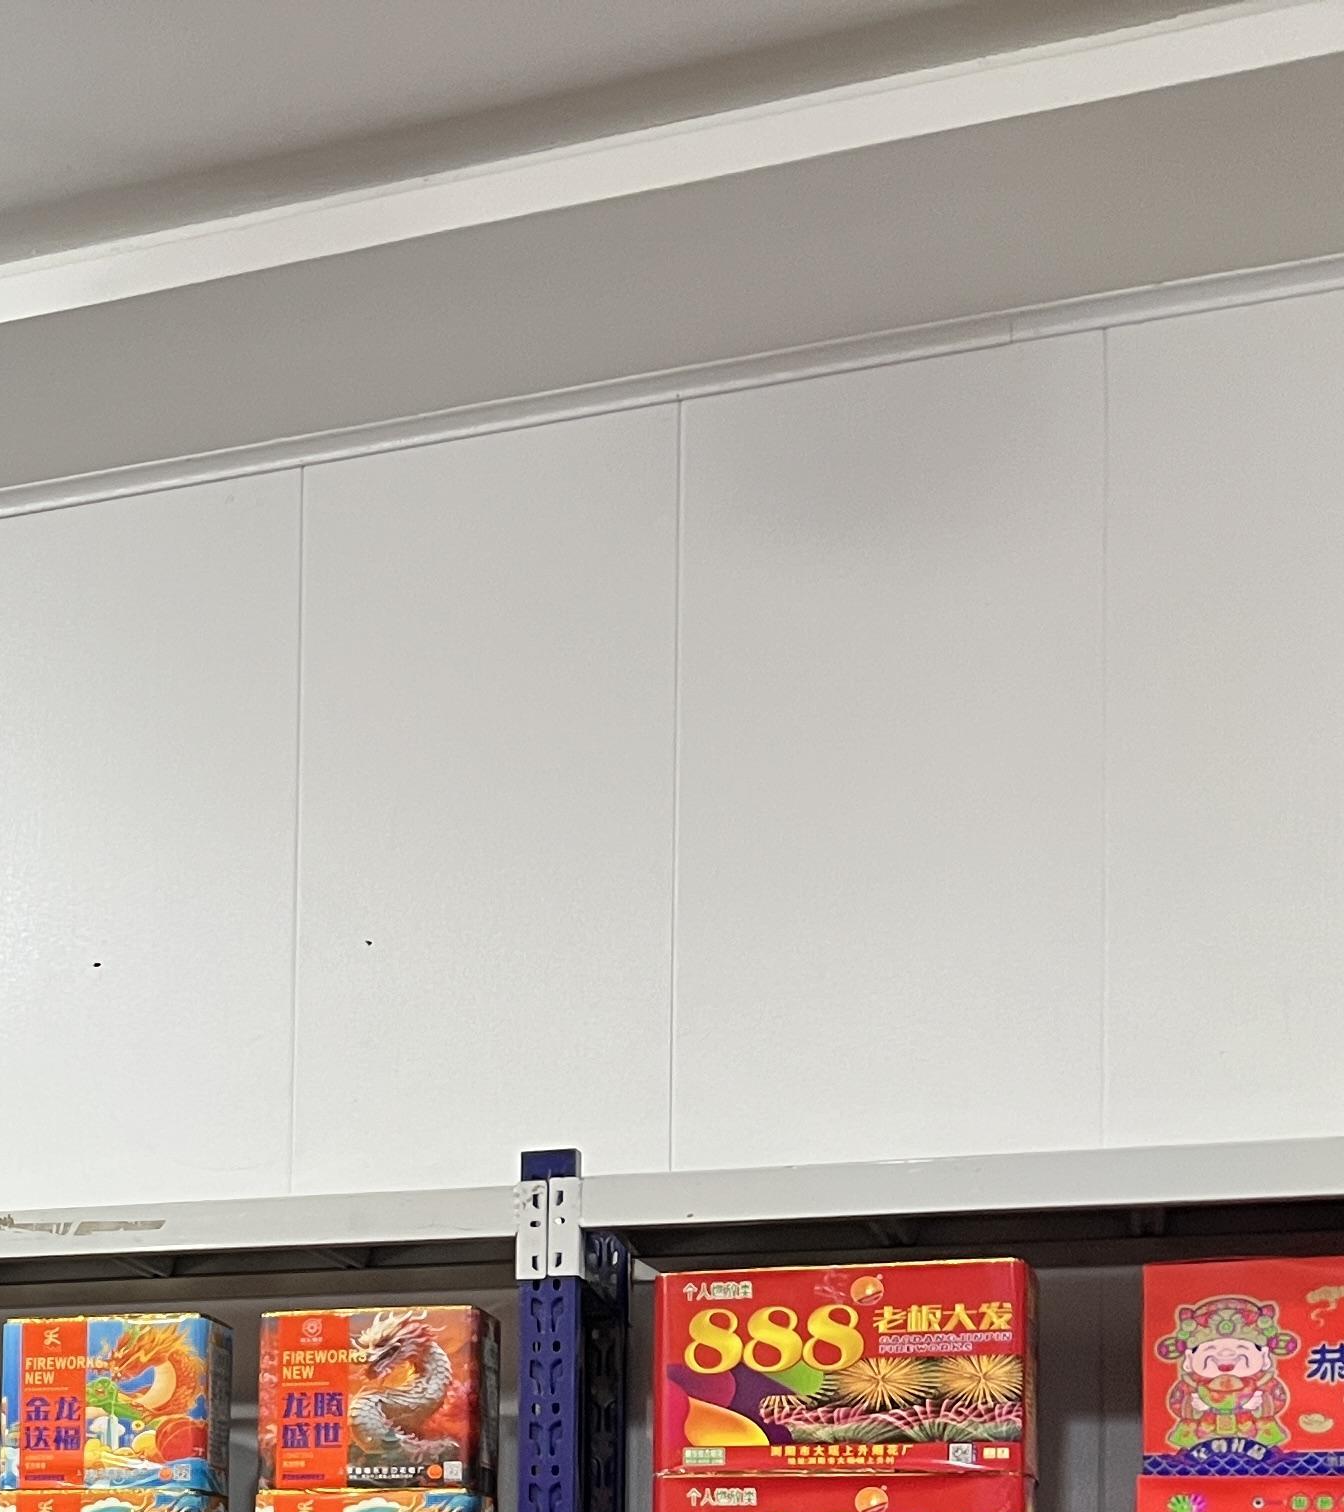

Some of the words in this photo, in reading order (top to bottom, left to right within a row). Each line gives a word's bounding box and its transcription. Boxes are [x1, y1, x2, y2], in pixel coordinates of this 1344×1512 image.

[873, 1302, 1012, 1333] 老板大发
[685, 1305, 864, 1374] 888
[283, 1350, 368, 1364] FIREWORKS
[24, 1371, 55, 1384] NEW
[282, 1366, 314, 1379] NEW
